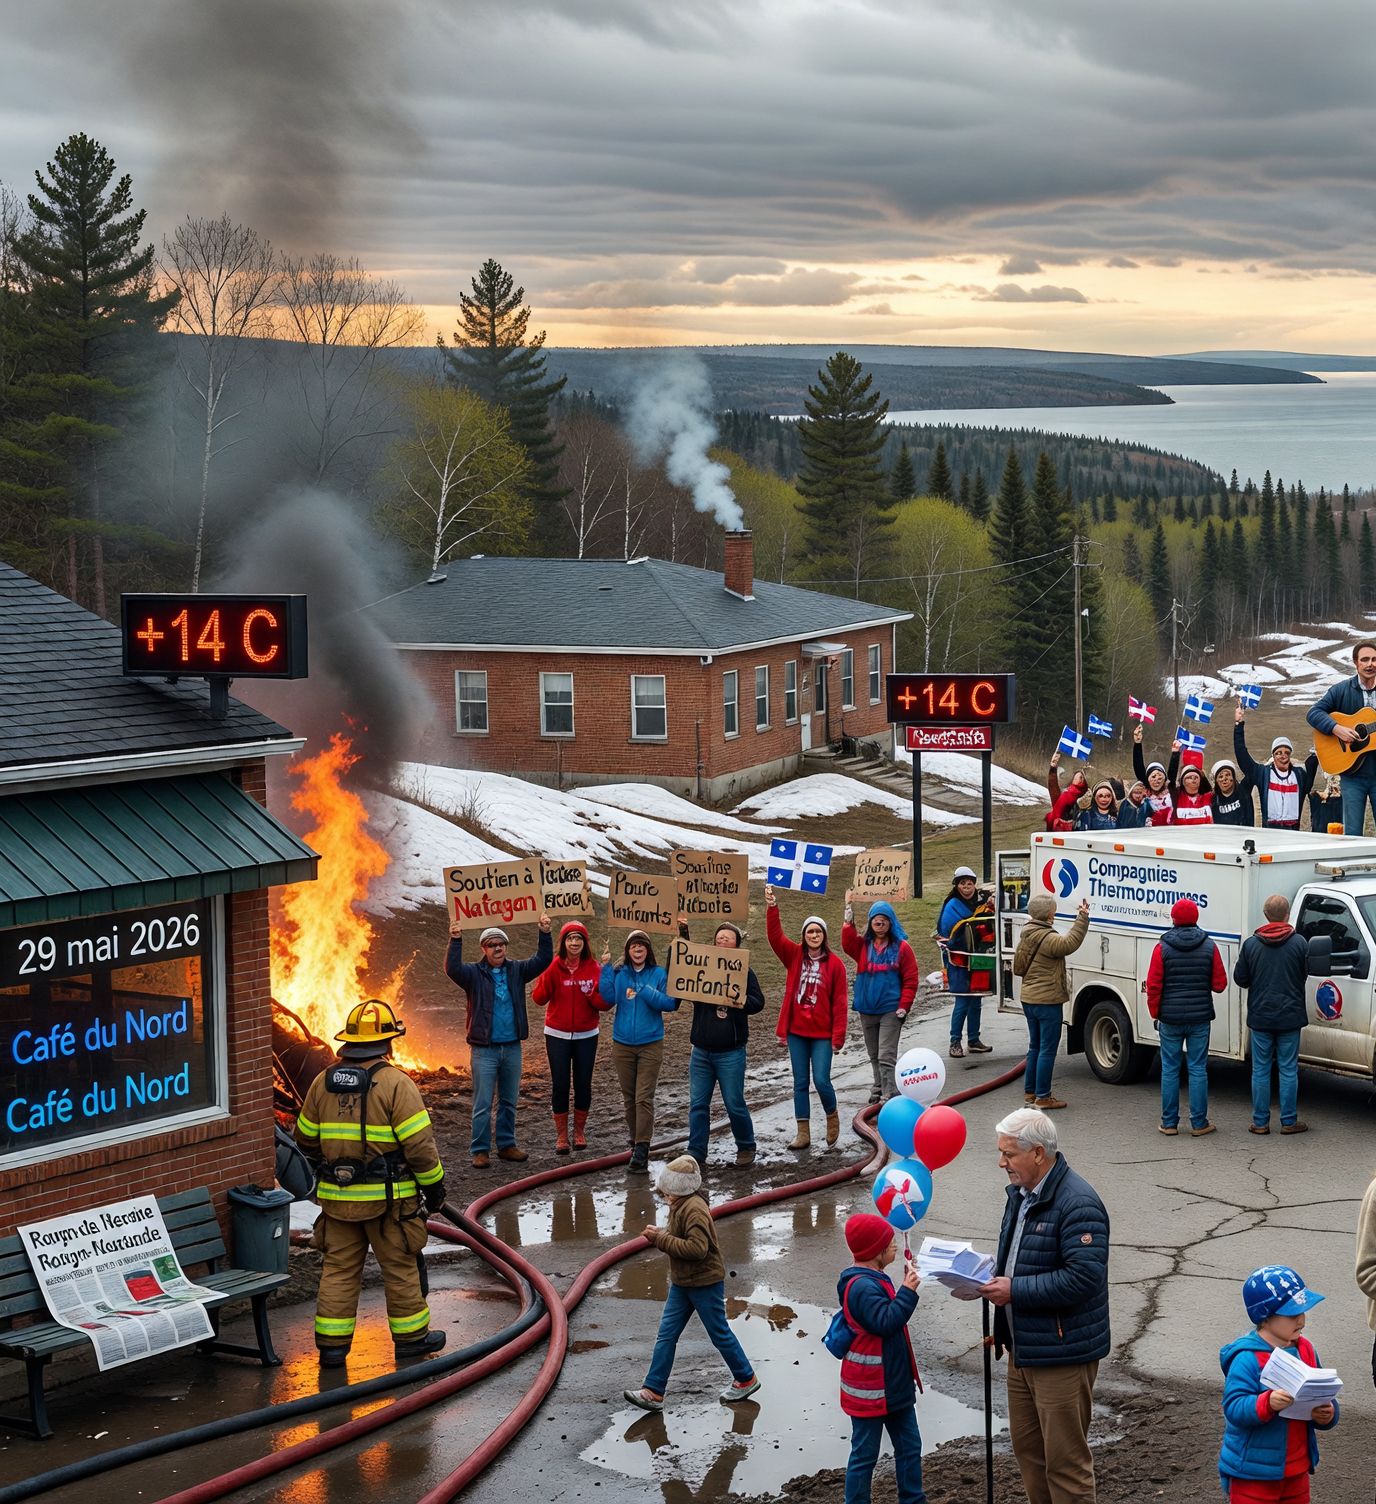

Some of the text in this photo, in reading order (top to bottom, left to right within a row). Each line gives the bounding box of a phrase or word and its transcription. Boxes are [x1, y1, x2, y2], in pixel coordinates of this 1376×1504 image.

[137, 608, 279, 663] +14 C
[898, 682, 995, 715] +14 C
[450, 867, 519, 893] Soutien
[524, 867, 534, 884] à
[1088, 857, 1178, 884] Compagnies
[18, 913, 200, 975] 29 mai 2026
[676, 941, 710, 966] Pour
[675, 970, 740, 1001] enfants
[12, 1000, 187, 1065] Café du Nord
[6, 1062, 190, 1133] Café du Nord
